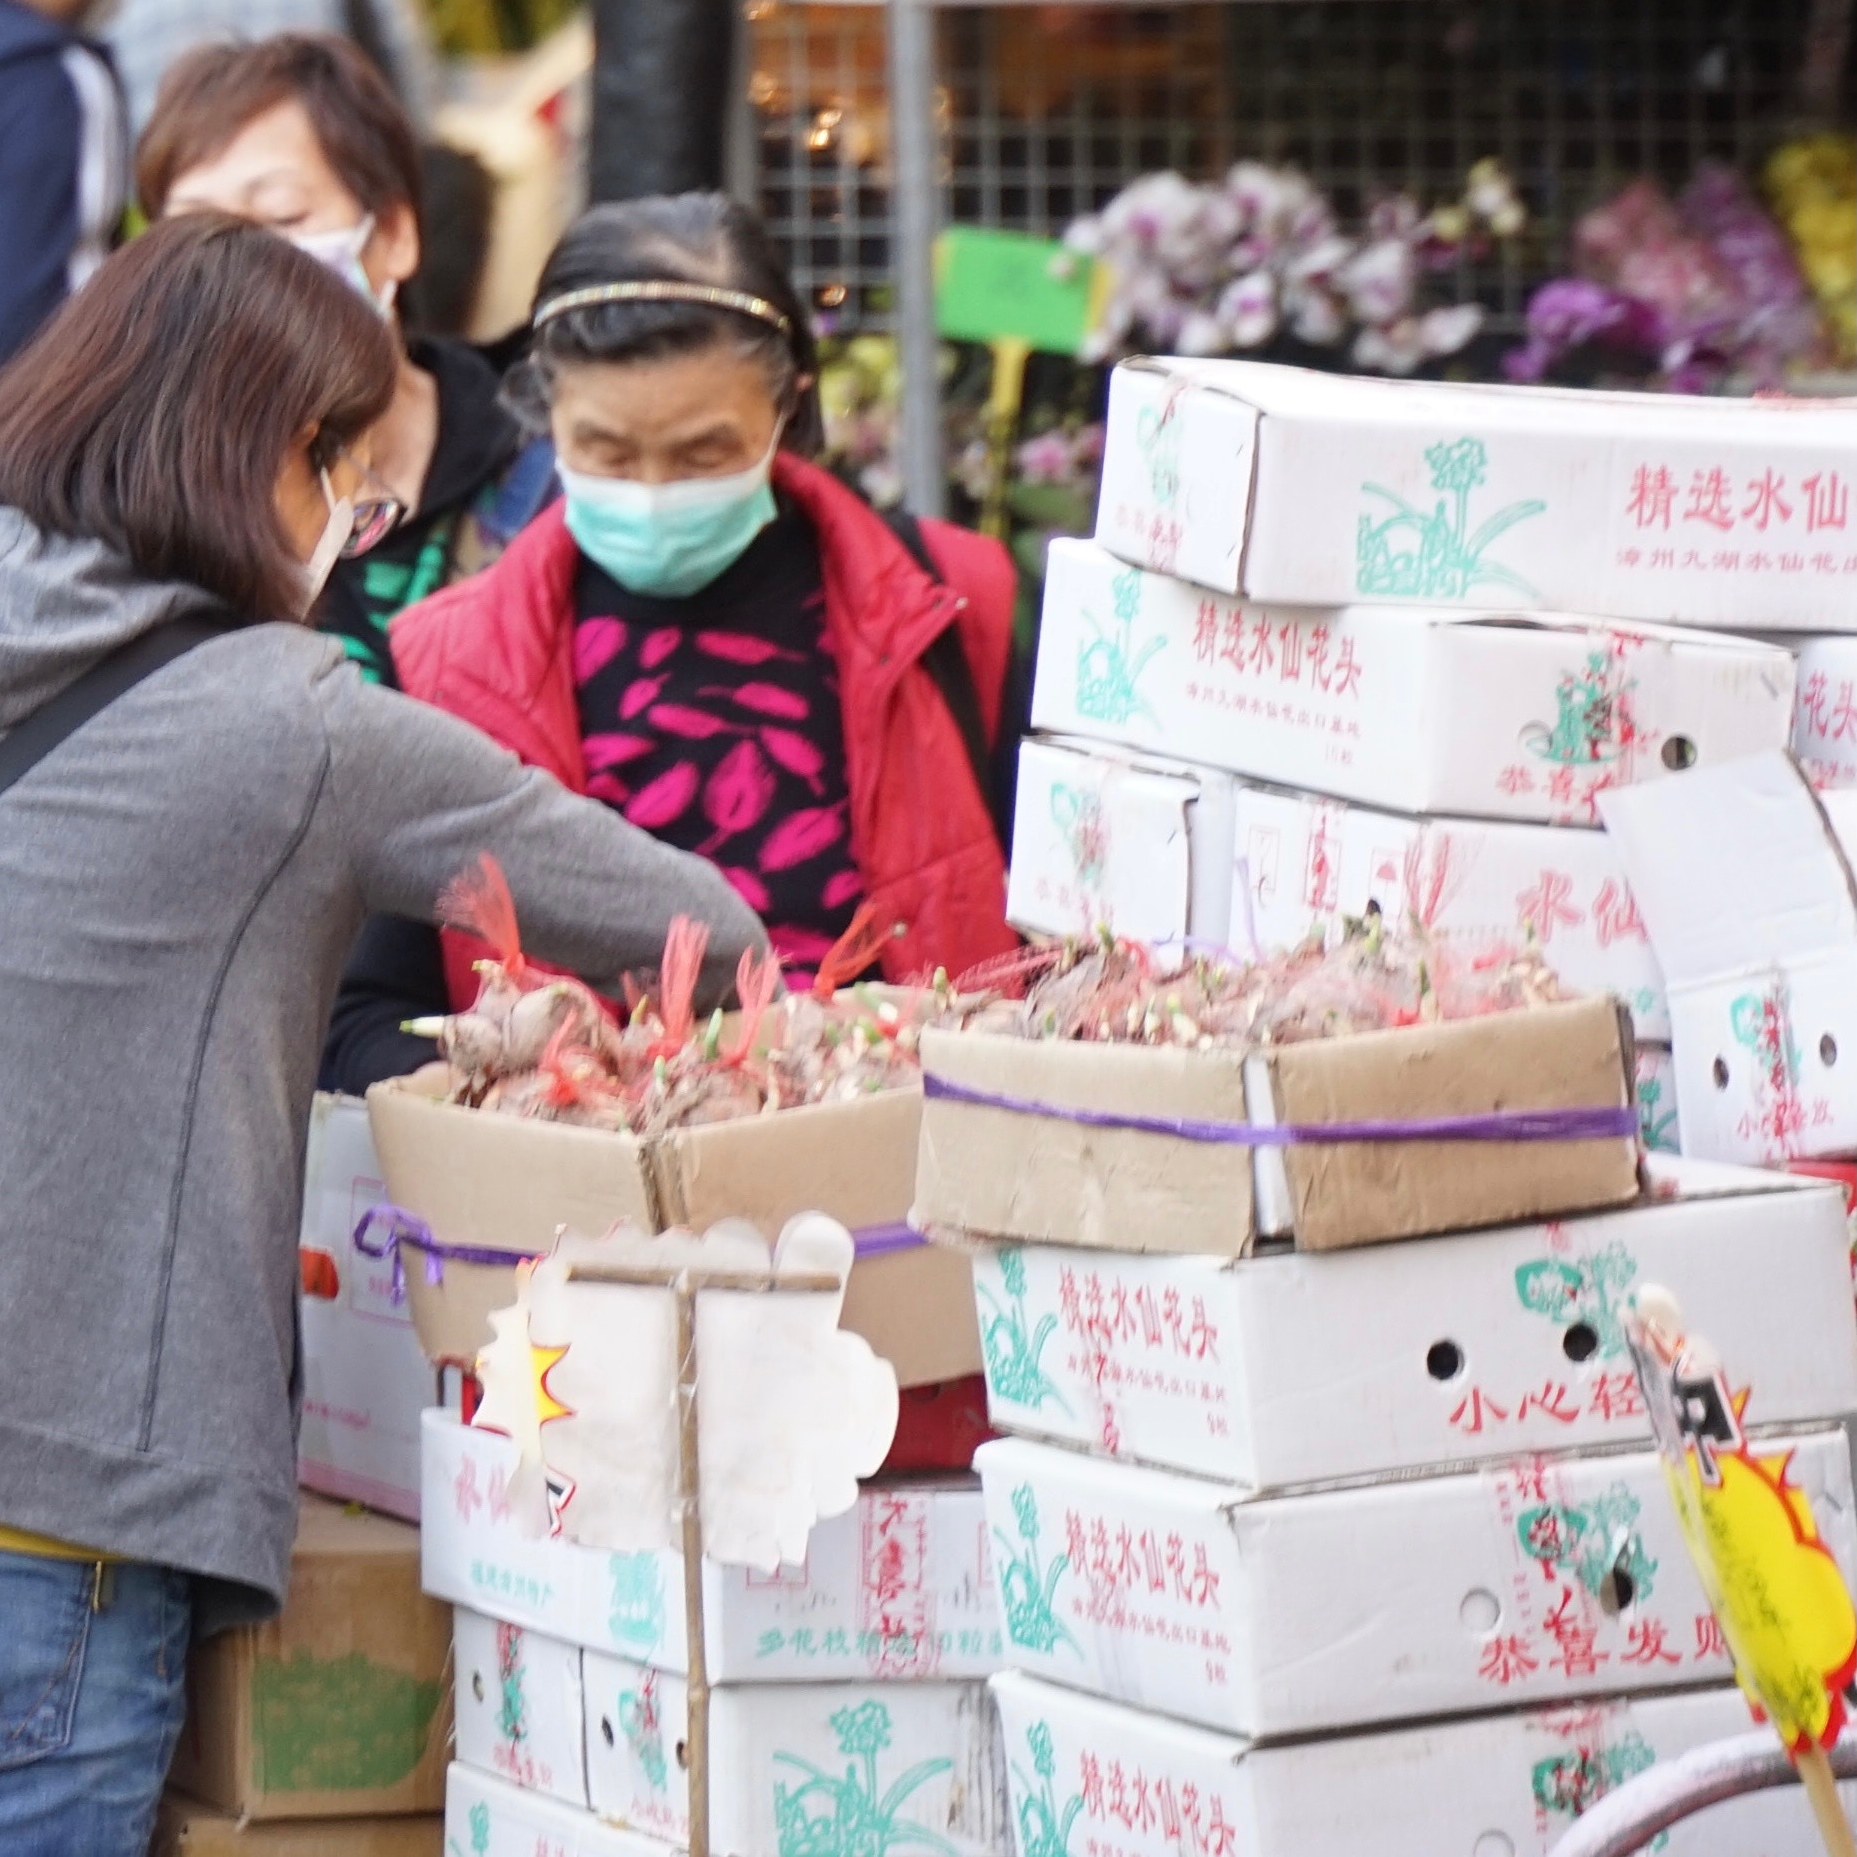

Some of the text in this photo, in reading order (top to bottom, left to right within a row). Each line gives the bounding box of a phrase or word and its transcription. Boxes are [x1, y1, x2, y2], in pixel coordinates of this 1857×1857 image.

[1626, 462, 1850, 533] 精选水仙
[1193, 598, 1363, 701] 精选水仙花头
[1059, 1262, 1220, 1364] 精选水仙花头
[1449, 1371, 1643, 1435] 小心轻
[1066, 1505, 1221, 1611] 精选水仙花头
[1081, 1747, 1238, 1857] 精选水仙花头
